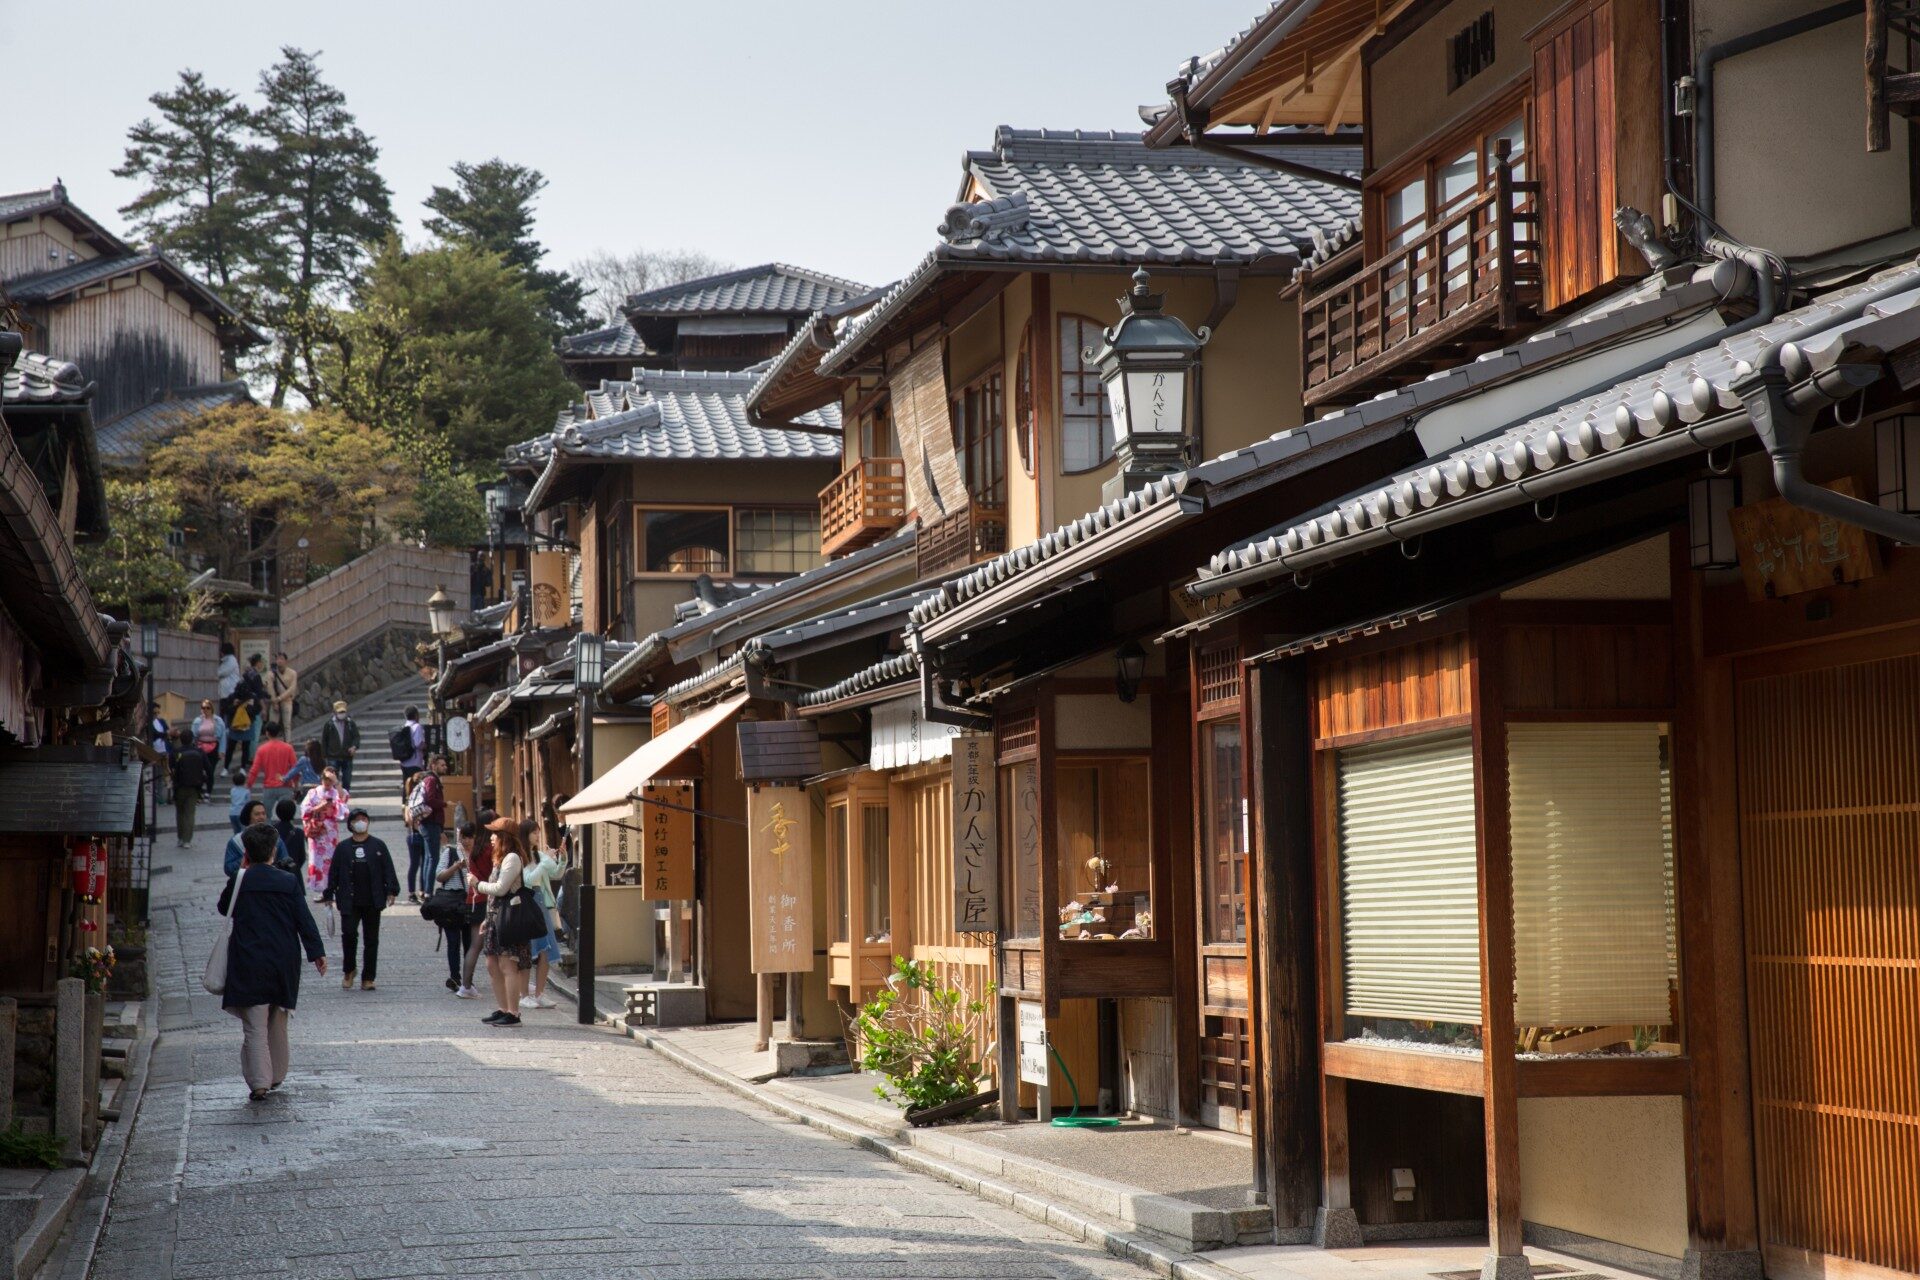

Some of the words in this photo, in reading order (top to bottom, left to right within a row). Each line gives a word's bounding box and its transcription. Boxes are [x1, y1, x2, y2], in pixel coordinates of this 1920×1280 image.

[963, 787, 988, 923] かんざし屋
[780, 894, 797, 954] 御香所
